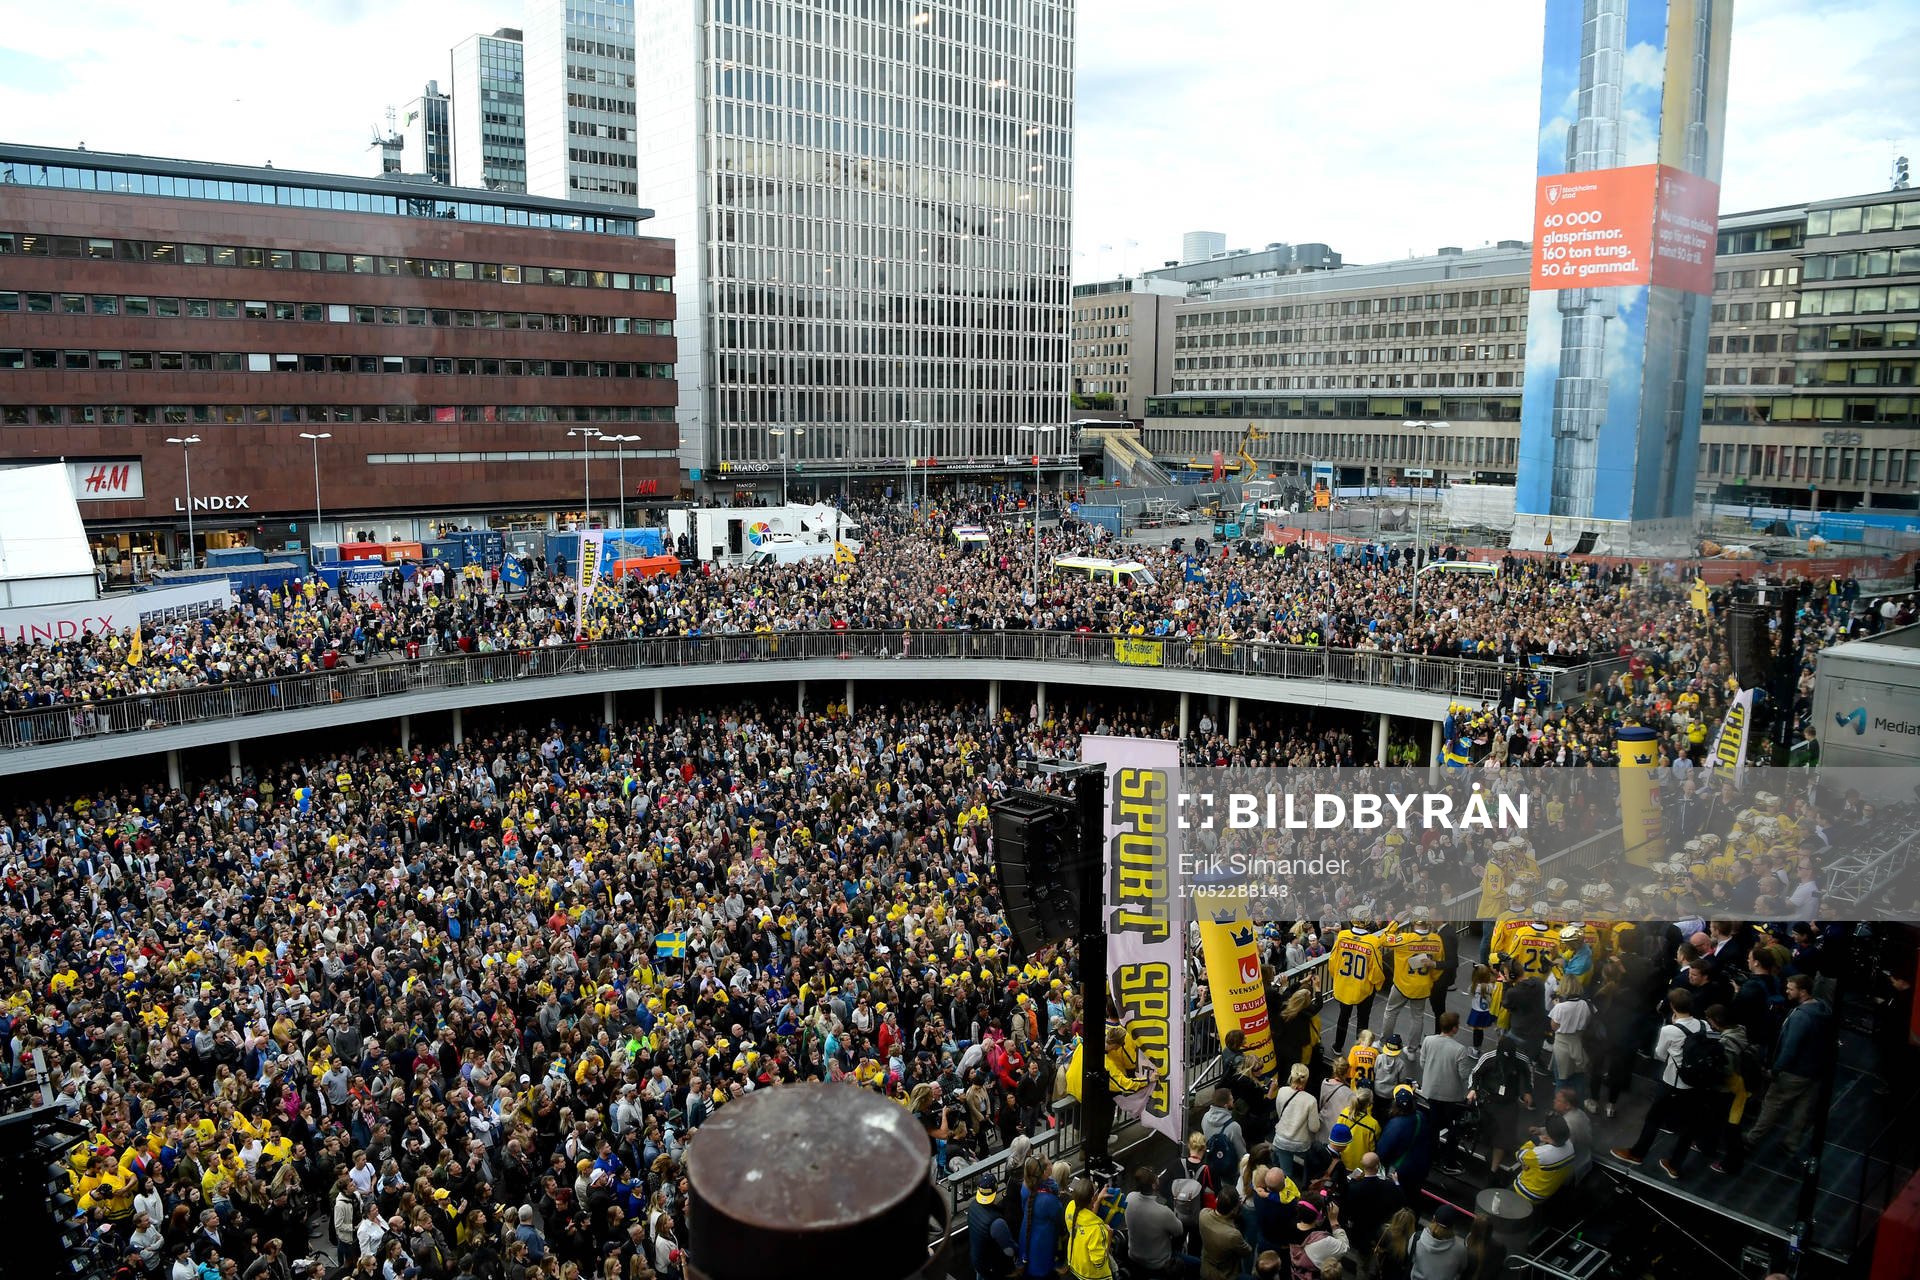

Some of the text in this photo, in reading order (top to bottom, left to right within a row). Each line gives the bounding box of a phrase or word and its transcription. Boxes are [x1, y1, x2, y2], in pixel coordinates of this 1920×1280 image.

[1544, 210, 1602, 227] 60 000
[1543, 228, 1623, 247] glasprismor.
[1542, 245, 1631, 260] 160 ton tung.
[1541, 258, 1639, 277] 50 år gammal.
[733, 463, 769, 472] MANGO
[85, 464, 129, 493] H&M
[636, 479, 657, 495] H&M
[175, 495, 250, 512] LINDEX
[1113, 768, 1169, 943] SPORT
[1340, 942, 1372, 955] BAUHAUS
[1339, 951, 1366, 980] 30
[1229, 983, 1259, 996] SVENSKA
